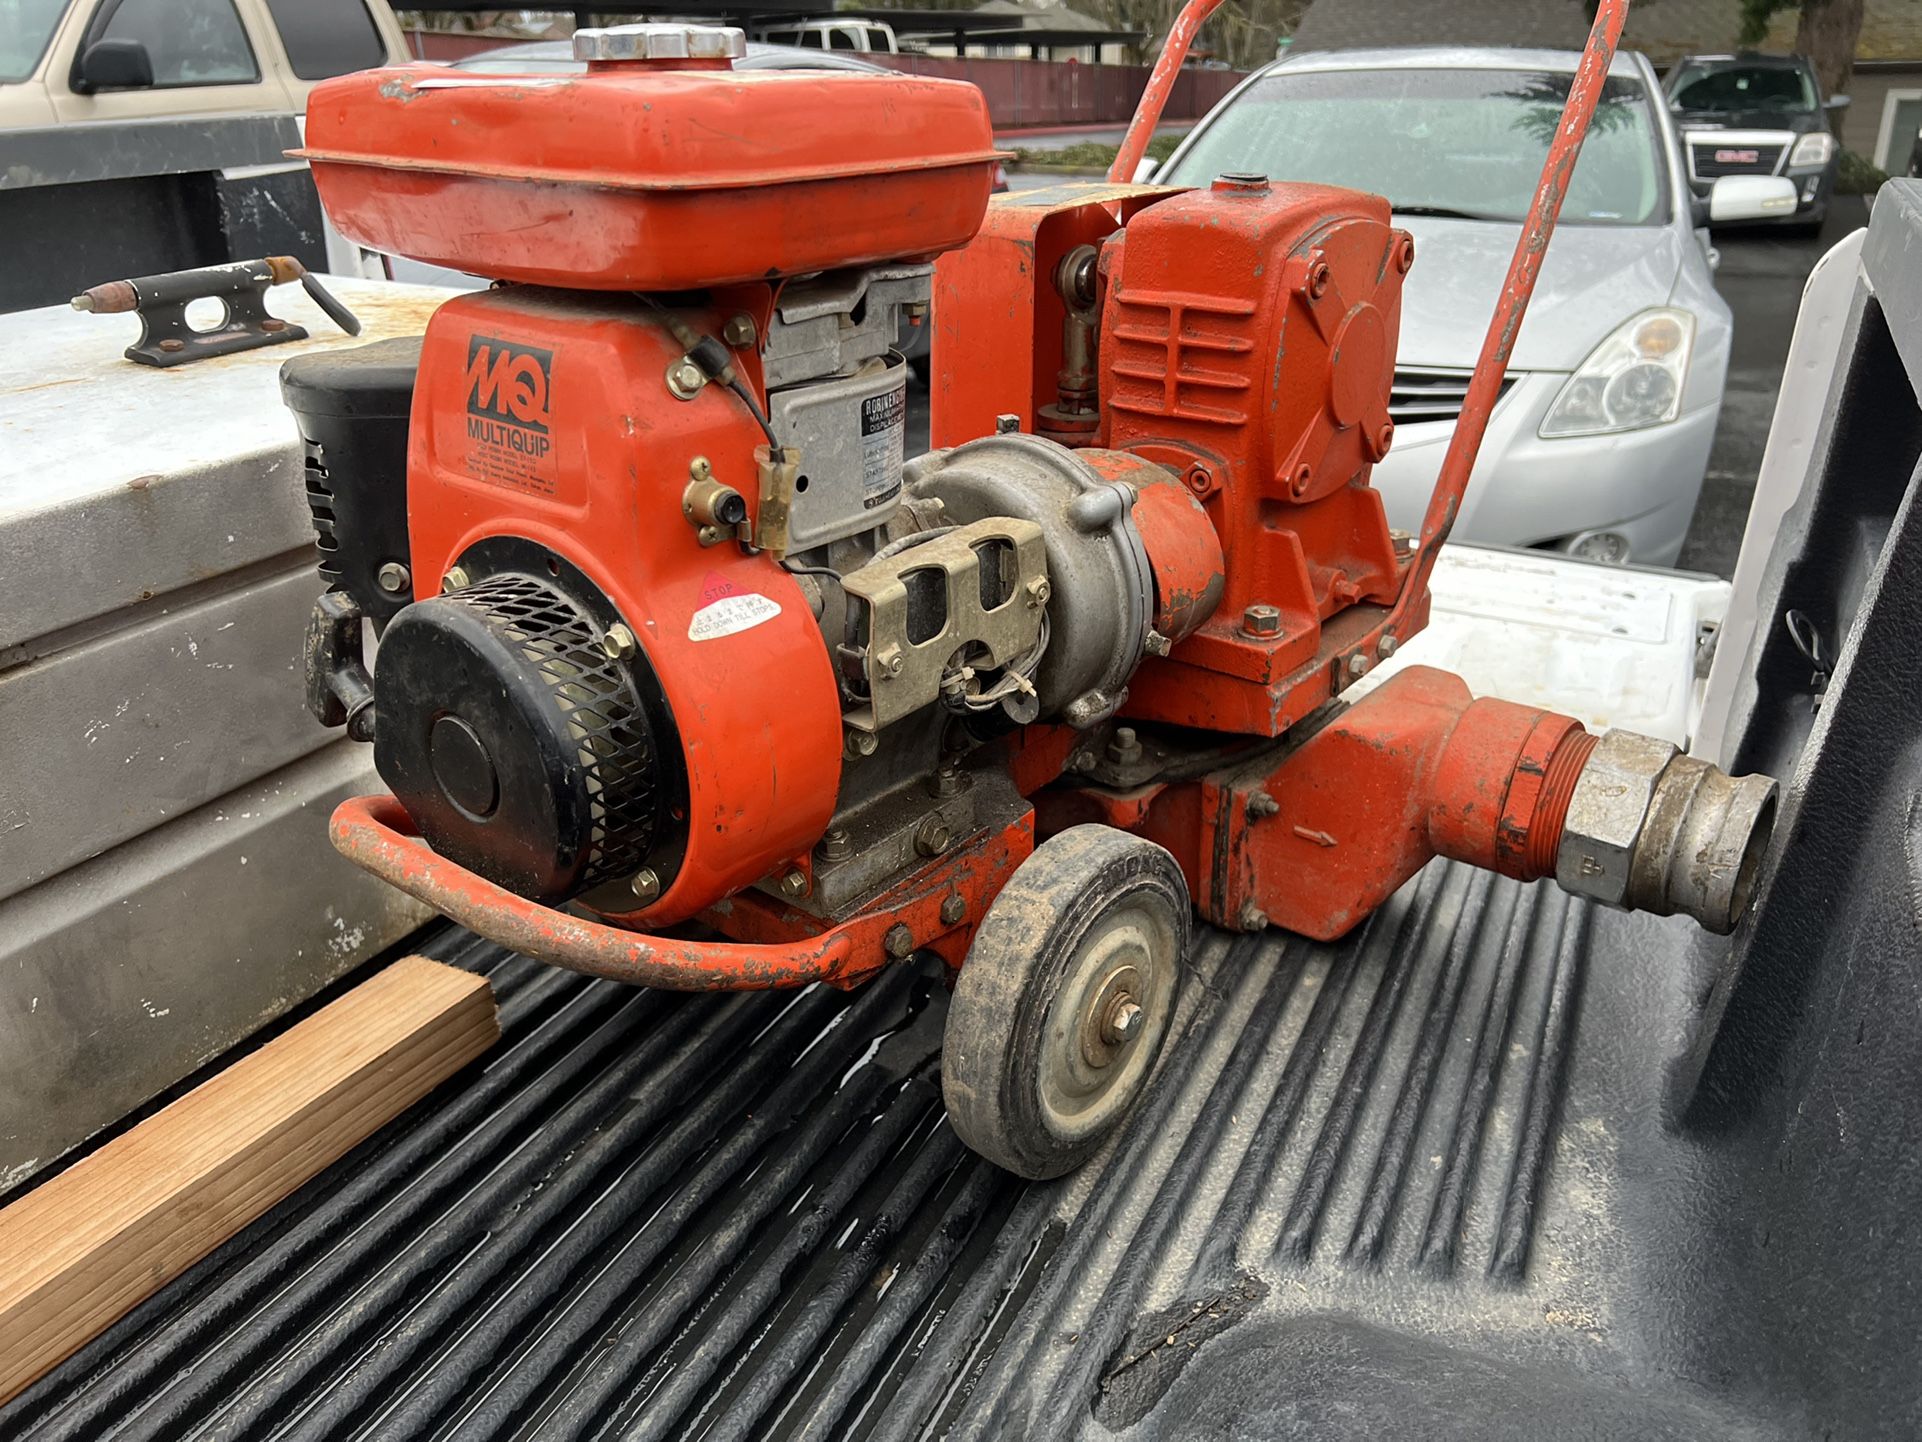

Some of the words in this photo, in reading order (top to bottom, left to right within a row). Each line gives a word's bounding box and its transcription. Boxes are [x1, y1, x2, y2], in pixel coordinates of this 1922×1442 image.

[1715, 149, 1759, 163] GMC
[466, 345, 549, 426] MQ
[467, 416, 550, 458] MULTIQUIP
[704, 583, 733, 601] STOP
[693, 623, 712, 637] HOLD
[713, 616, 733, 630] DOWN
